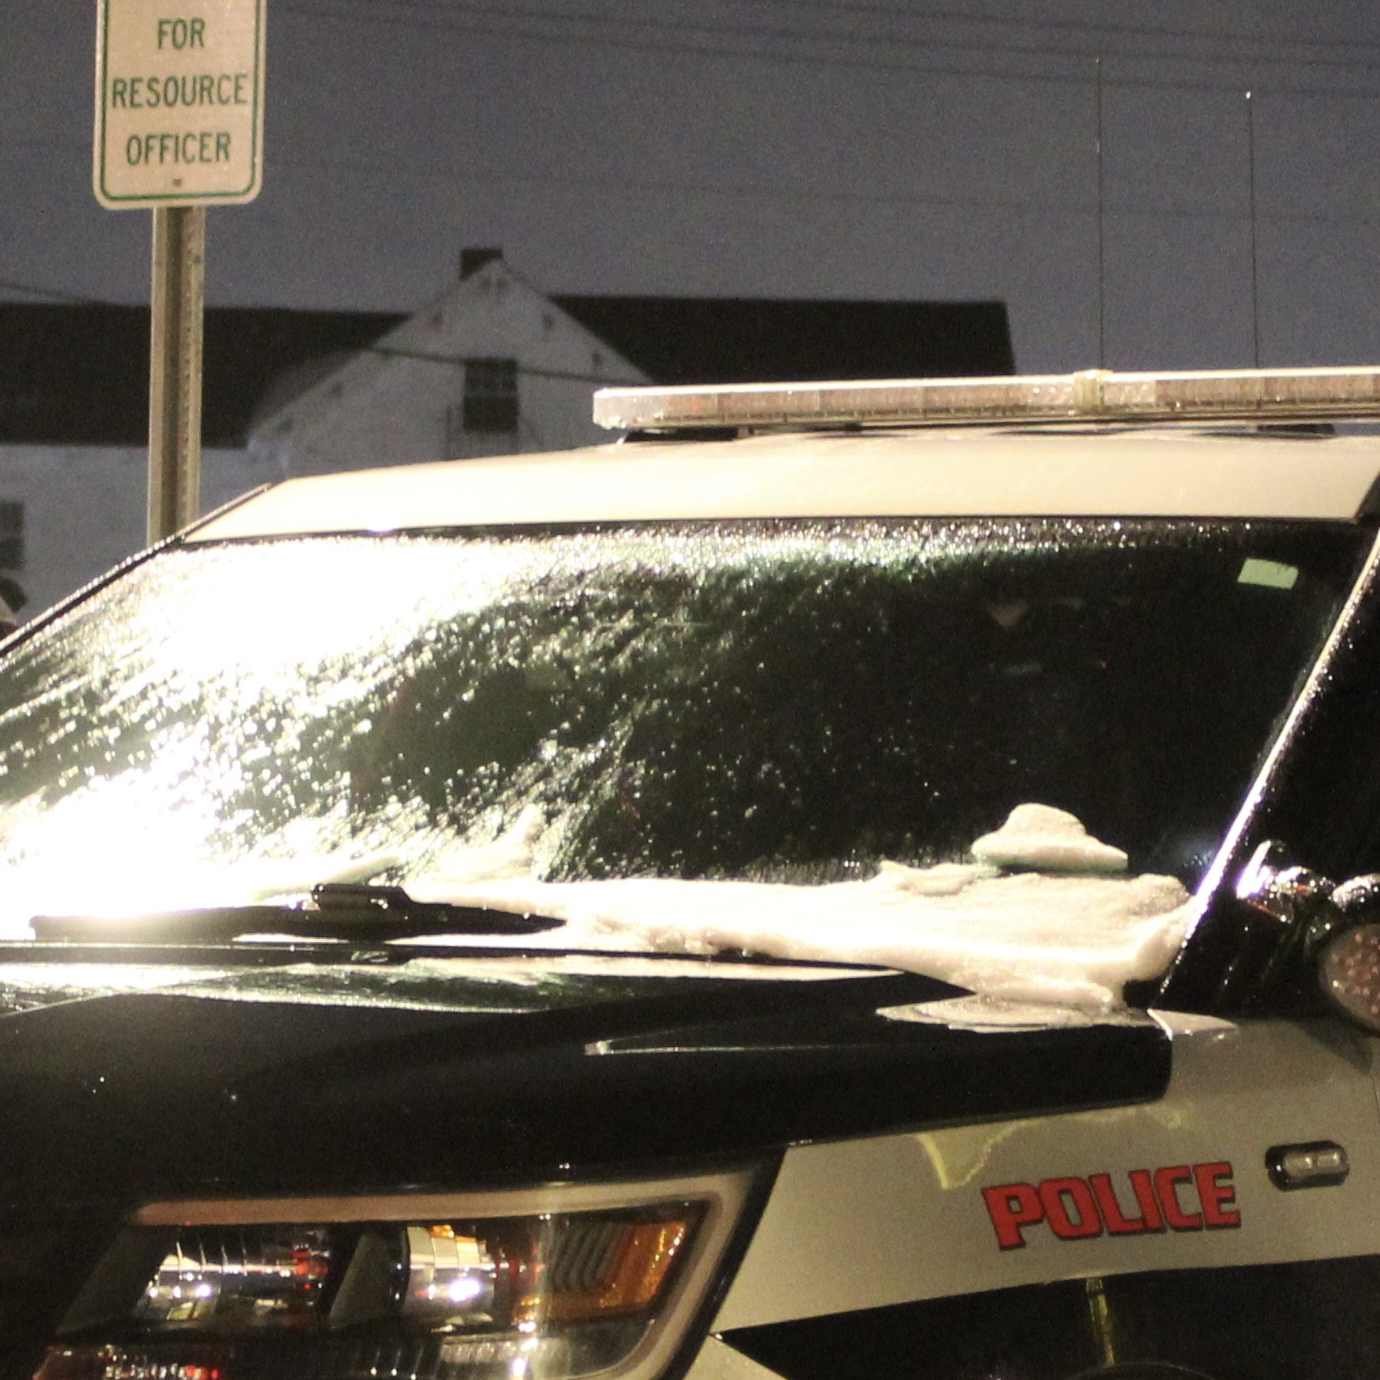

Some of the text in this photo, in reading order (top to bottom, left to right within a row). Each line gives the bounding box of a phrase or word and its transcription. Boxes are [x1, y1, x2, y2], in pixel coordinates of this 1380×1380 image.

[158, 17, 205, 50] FOR
[112, 73, 248, 109] RESOURCE
[126, 131, 230, 166] OFFICER
[981, 1161, 1241, 1252] POLICE
